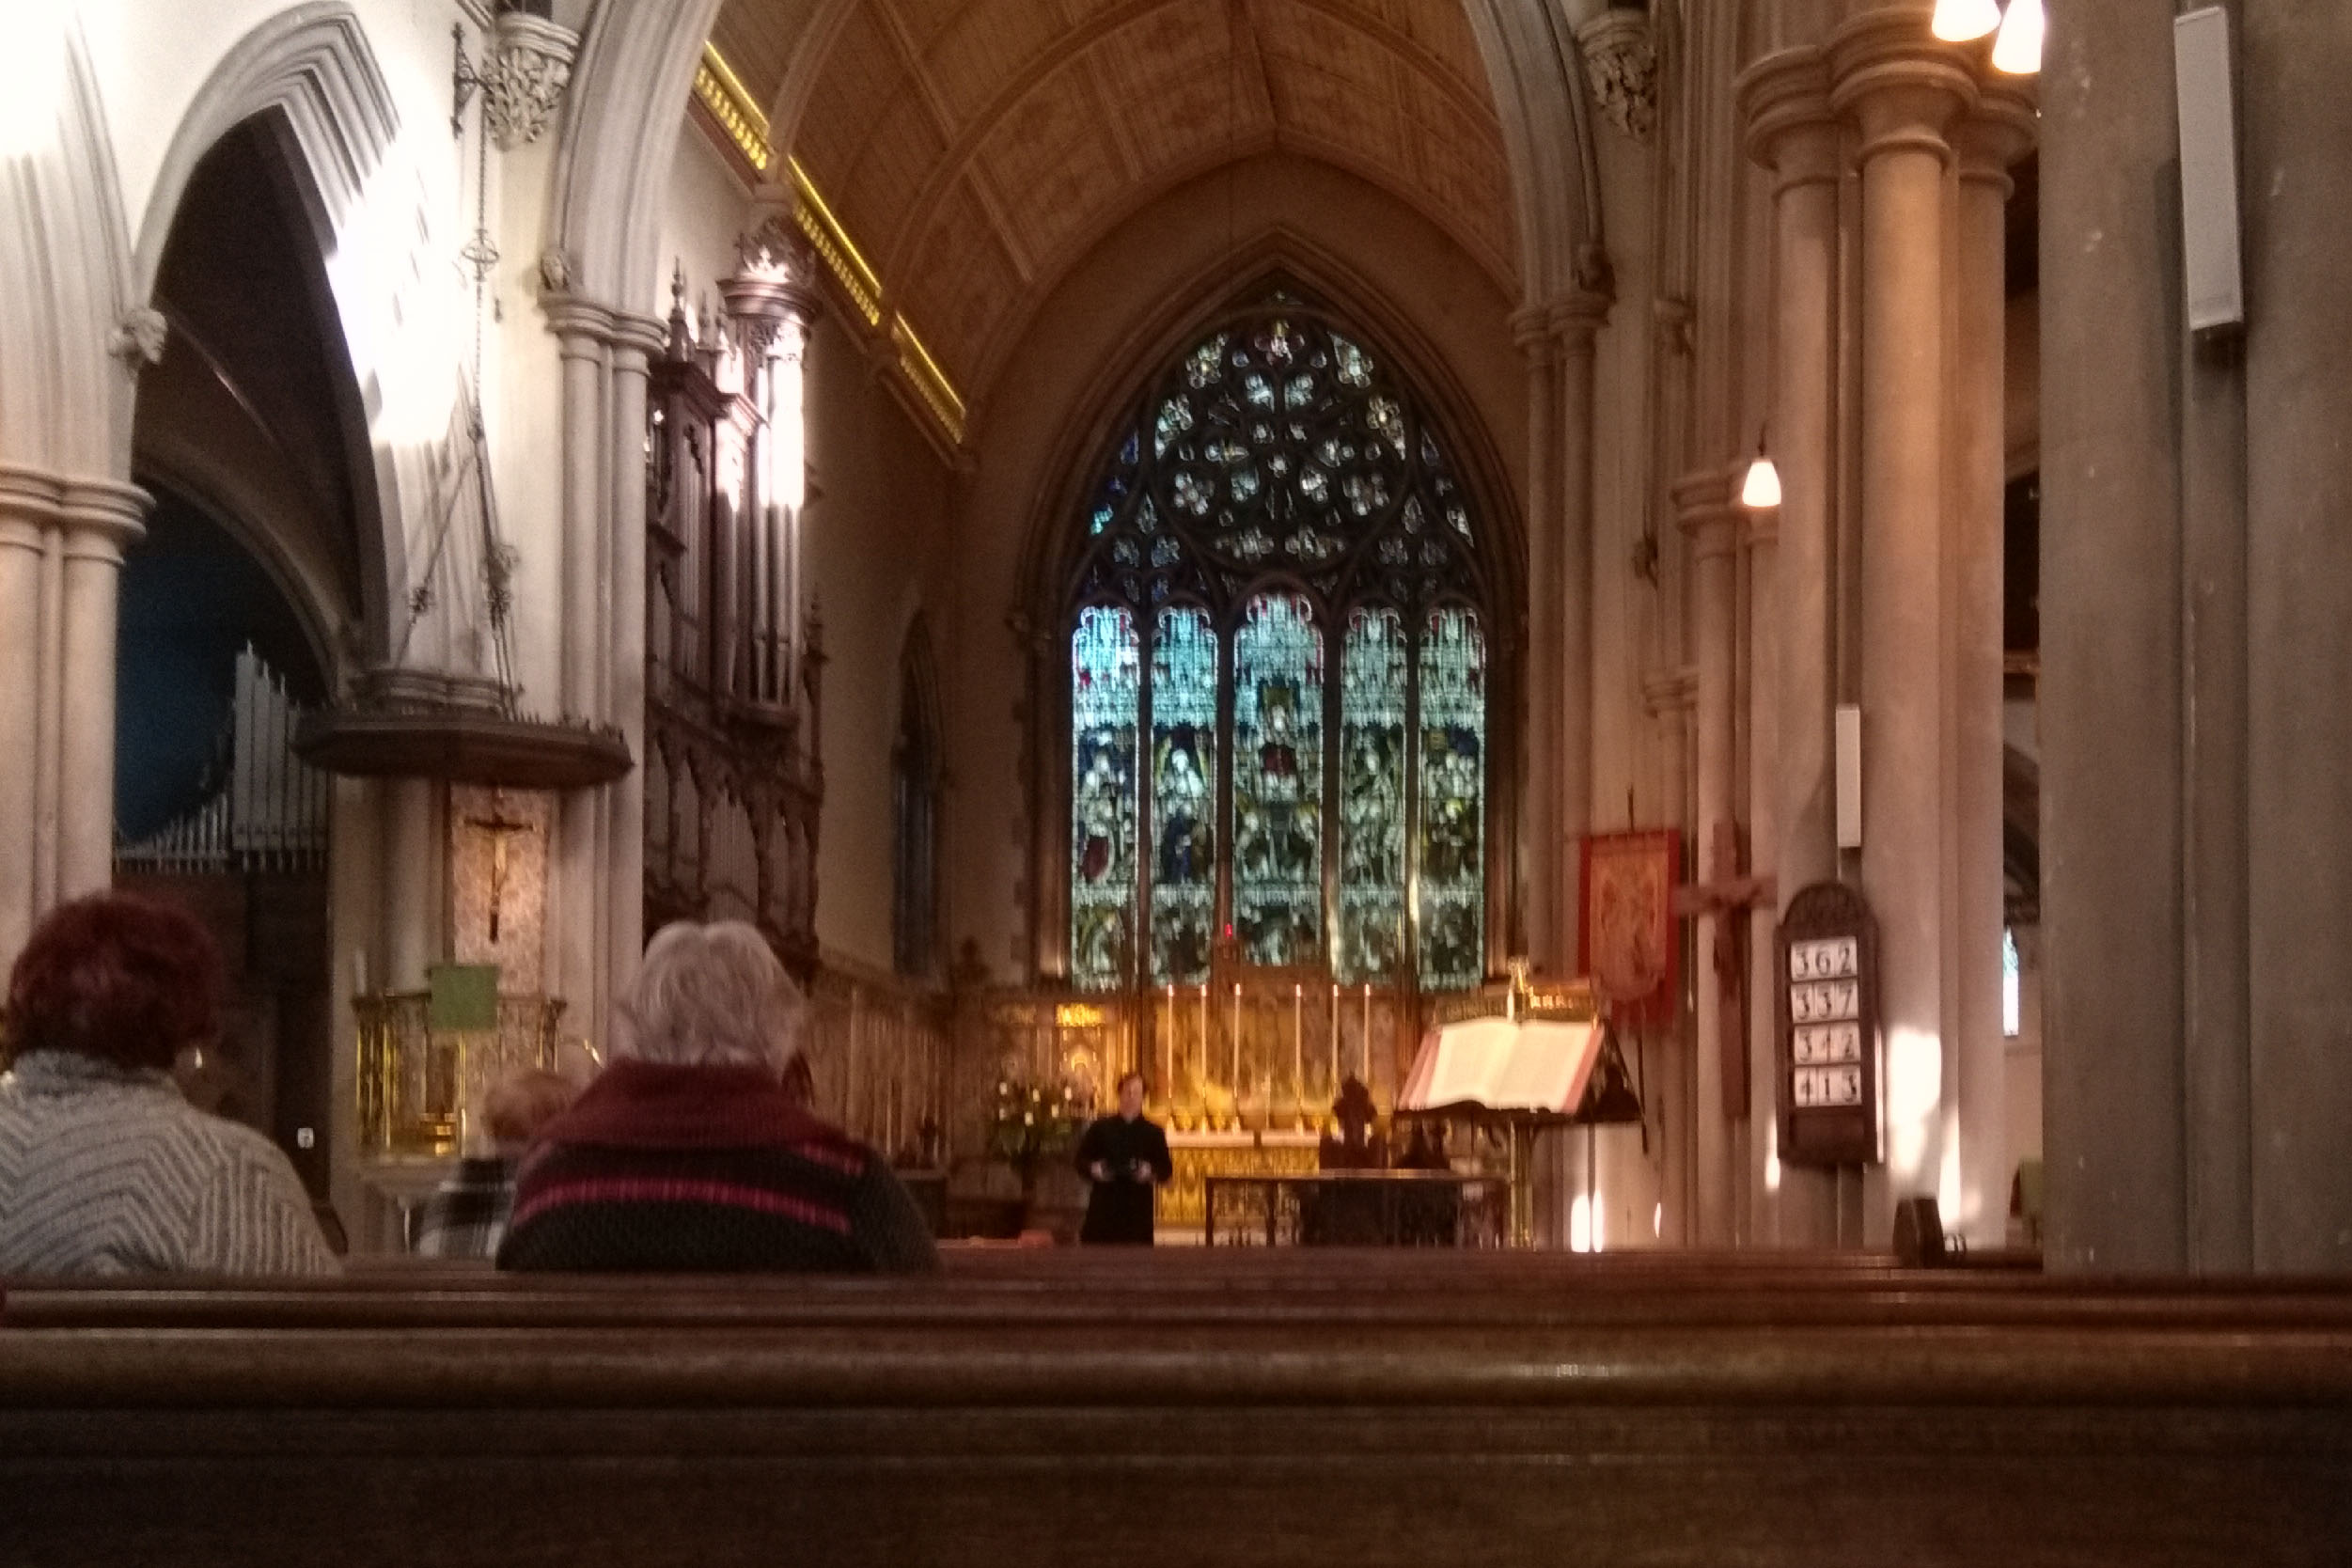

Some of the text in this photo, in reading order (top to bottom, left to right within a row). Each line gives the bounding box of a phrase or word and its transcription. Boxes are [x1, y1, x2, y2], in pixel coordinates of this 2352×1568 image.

[1795, 942, 1852, 978] 362
[1795, 983, 1853, 1020] 337
[1799, 1068, 1857, 1104] 413
